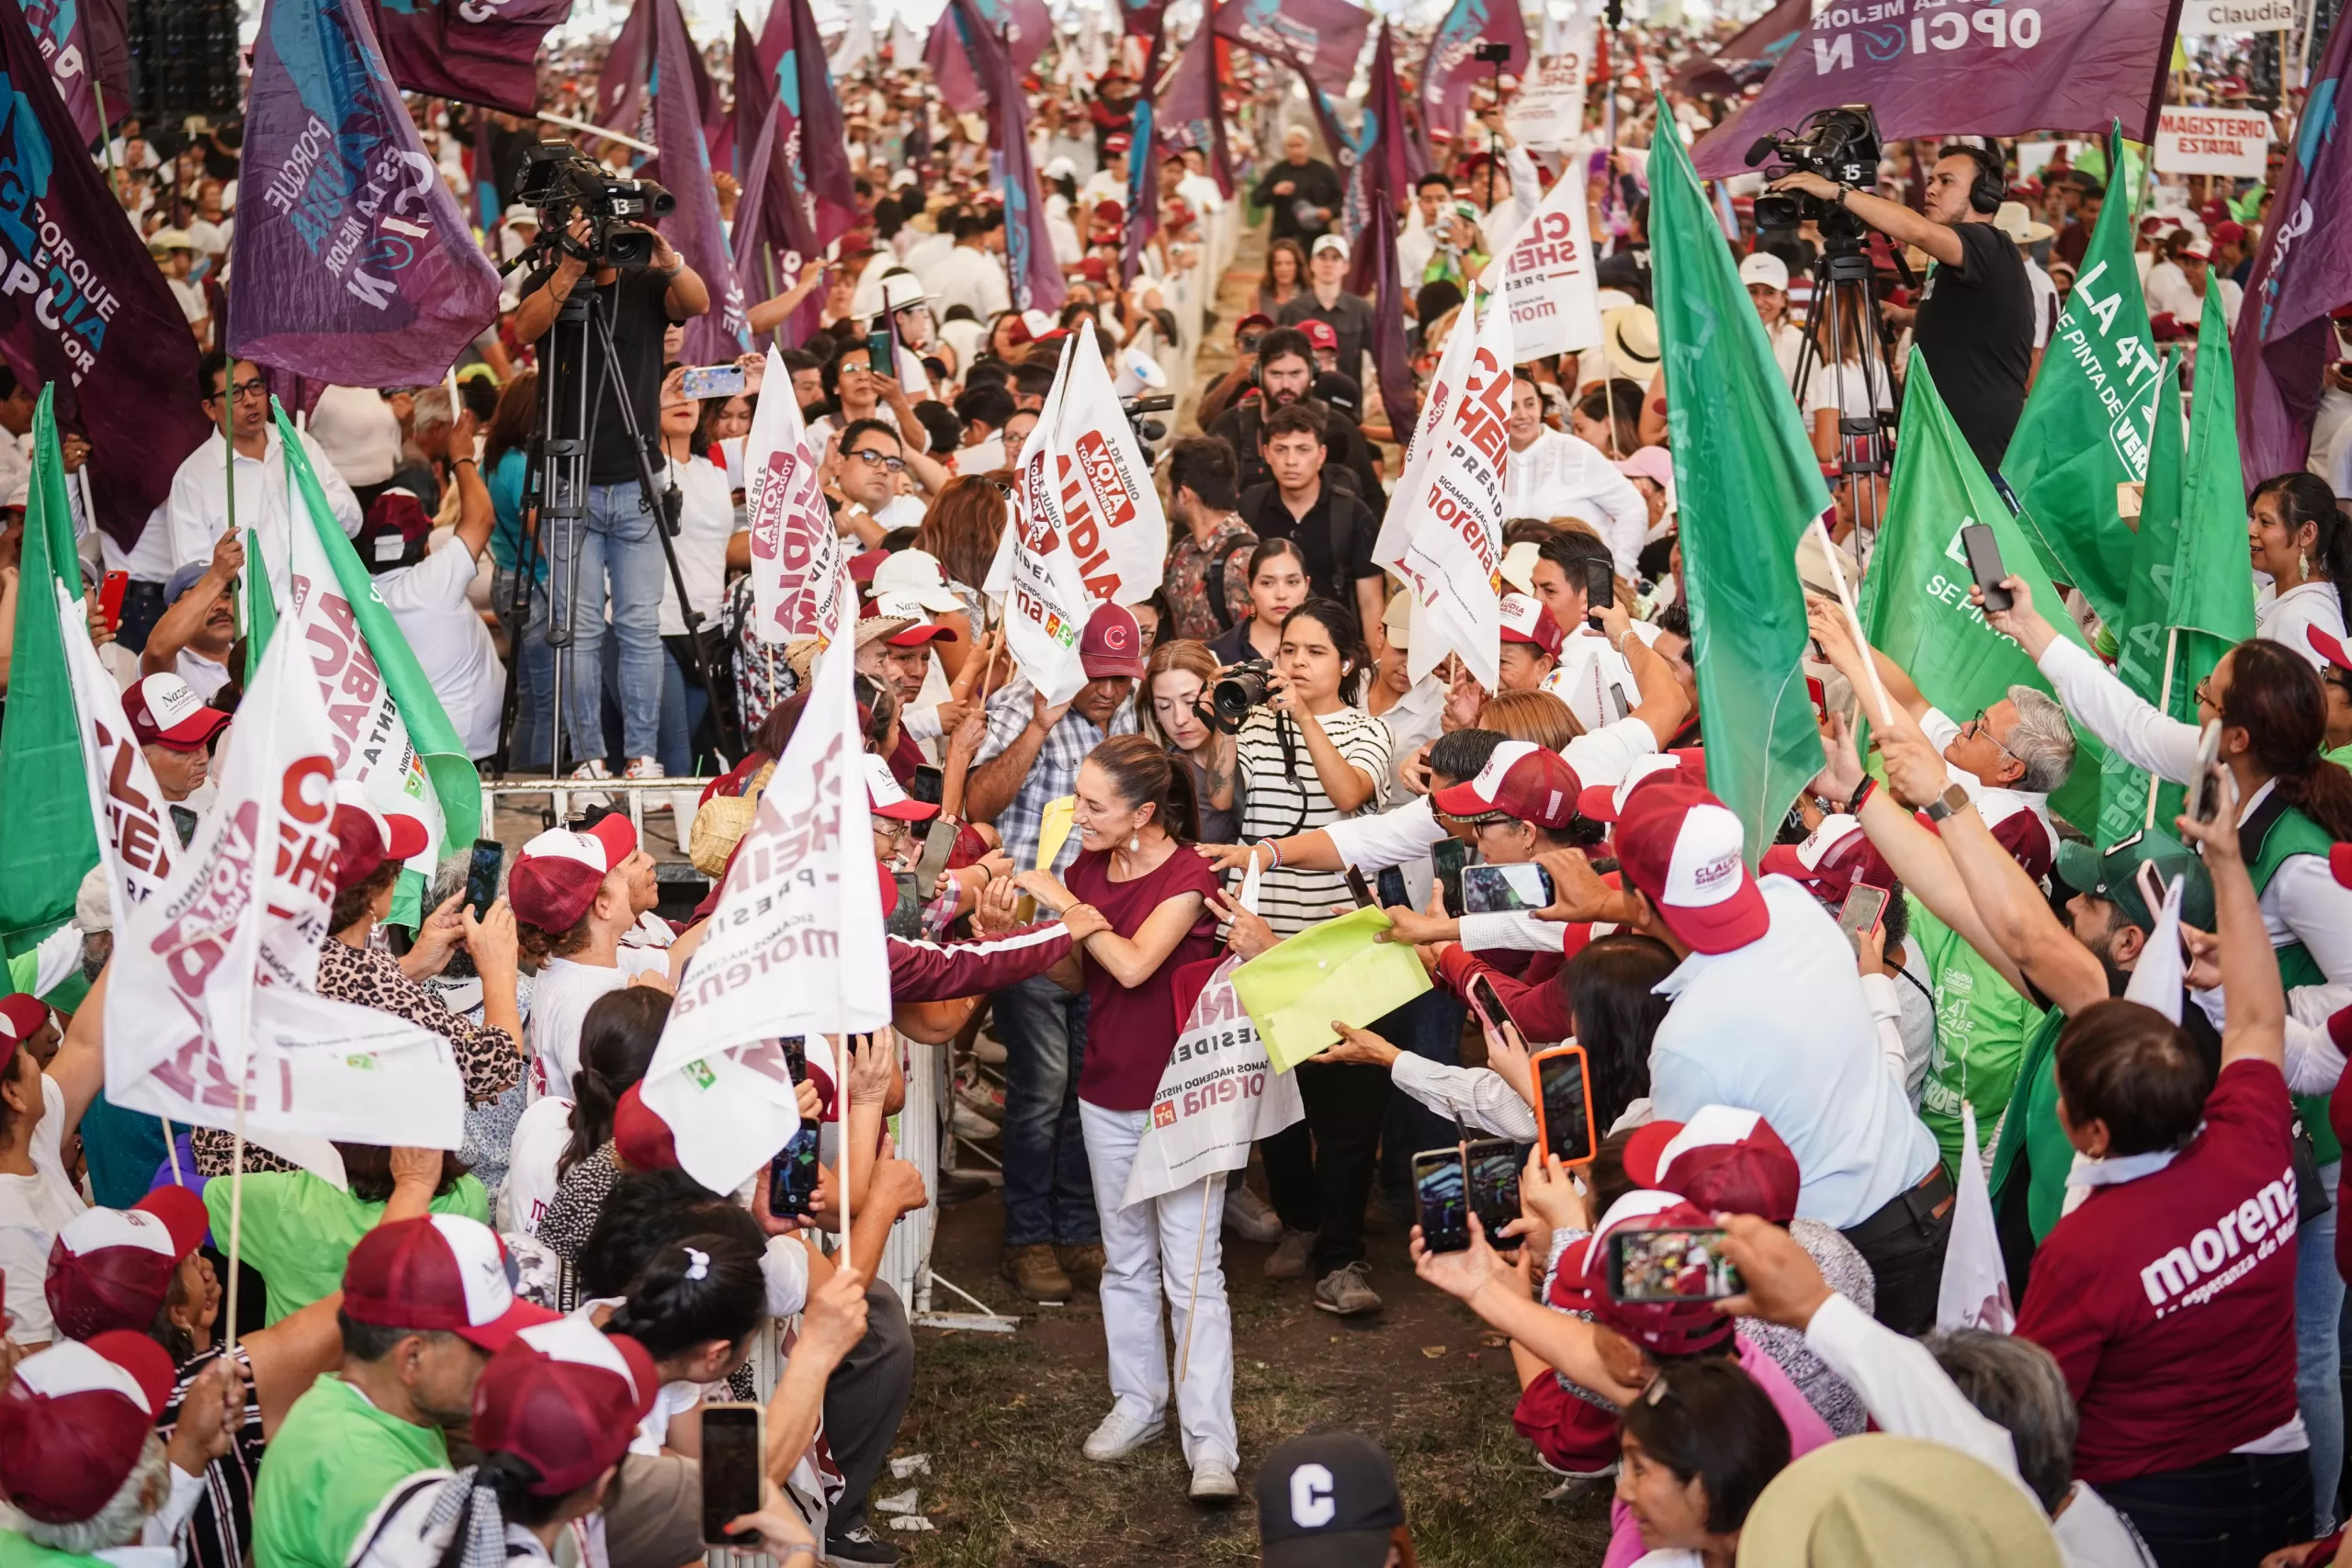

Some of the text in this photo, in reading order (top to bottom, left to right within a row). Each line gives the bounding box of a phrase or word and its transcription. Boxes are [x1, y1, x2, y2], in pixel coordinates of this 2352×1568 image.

[2208, 1, 2291, 24] Claudia
[2159, 114, 2267, 139] MAGISTERIO
[1813, 157, 1825, 166] 15
[2178, 138, 2245, 156] ESTATAL
[1842, 164, 1861, 181] 15
[612, 197, 632, 215] 13
[2074, 260, 2160, 387] LA 4T
[2062, 329, 2107, 390] PINTA
[2099, 386, 2124, 419] DE
[1031, 458, 1040, 495] TODO
[1077, 442, 1117, 525] TODO MORENA
[1091, 443, 1128, 513] VOTA
[1107, 437, 1140, 502] 2 DE JUNIO
[1439, 476, 1474, 510] SIGAMOS
[1040, 489, 1062, 529] JUNIO
[1944, 515, 1974, 570] L
[1926, 574, 1962, 605] SE
[1104, 625, 1127, 650] C
[1947, 998, 1970, 1019] 4T
[1957, 1020, 1974, 1032] DE
[2257, 1237, 2278, 1260] de
[1290, 1462, 1336, 1529] C
